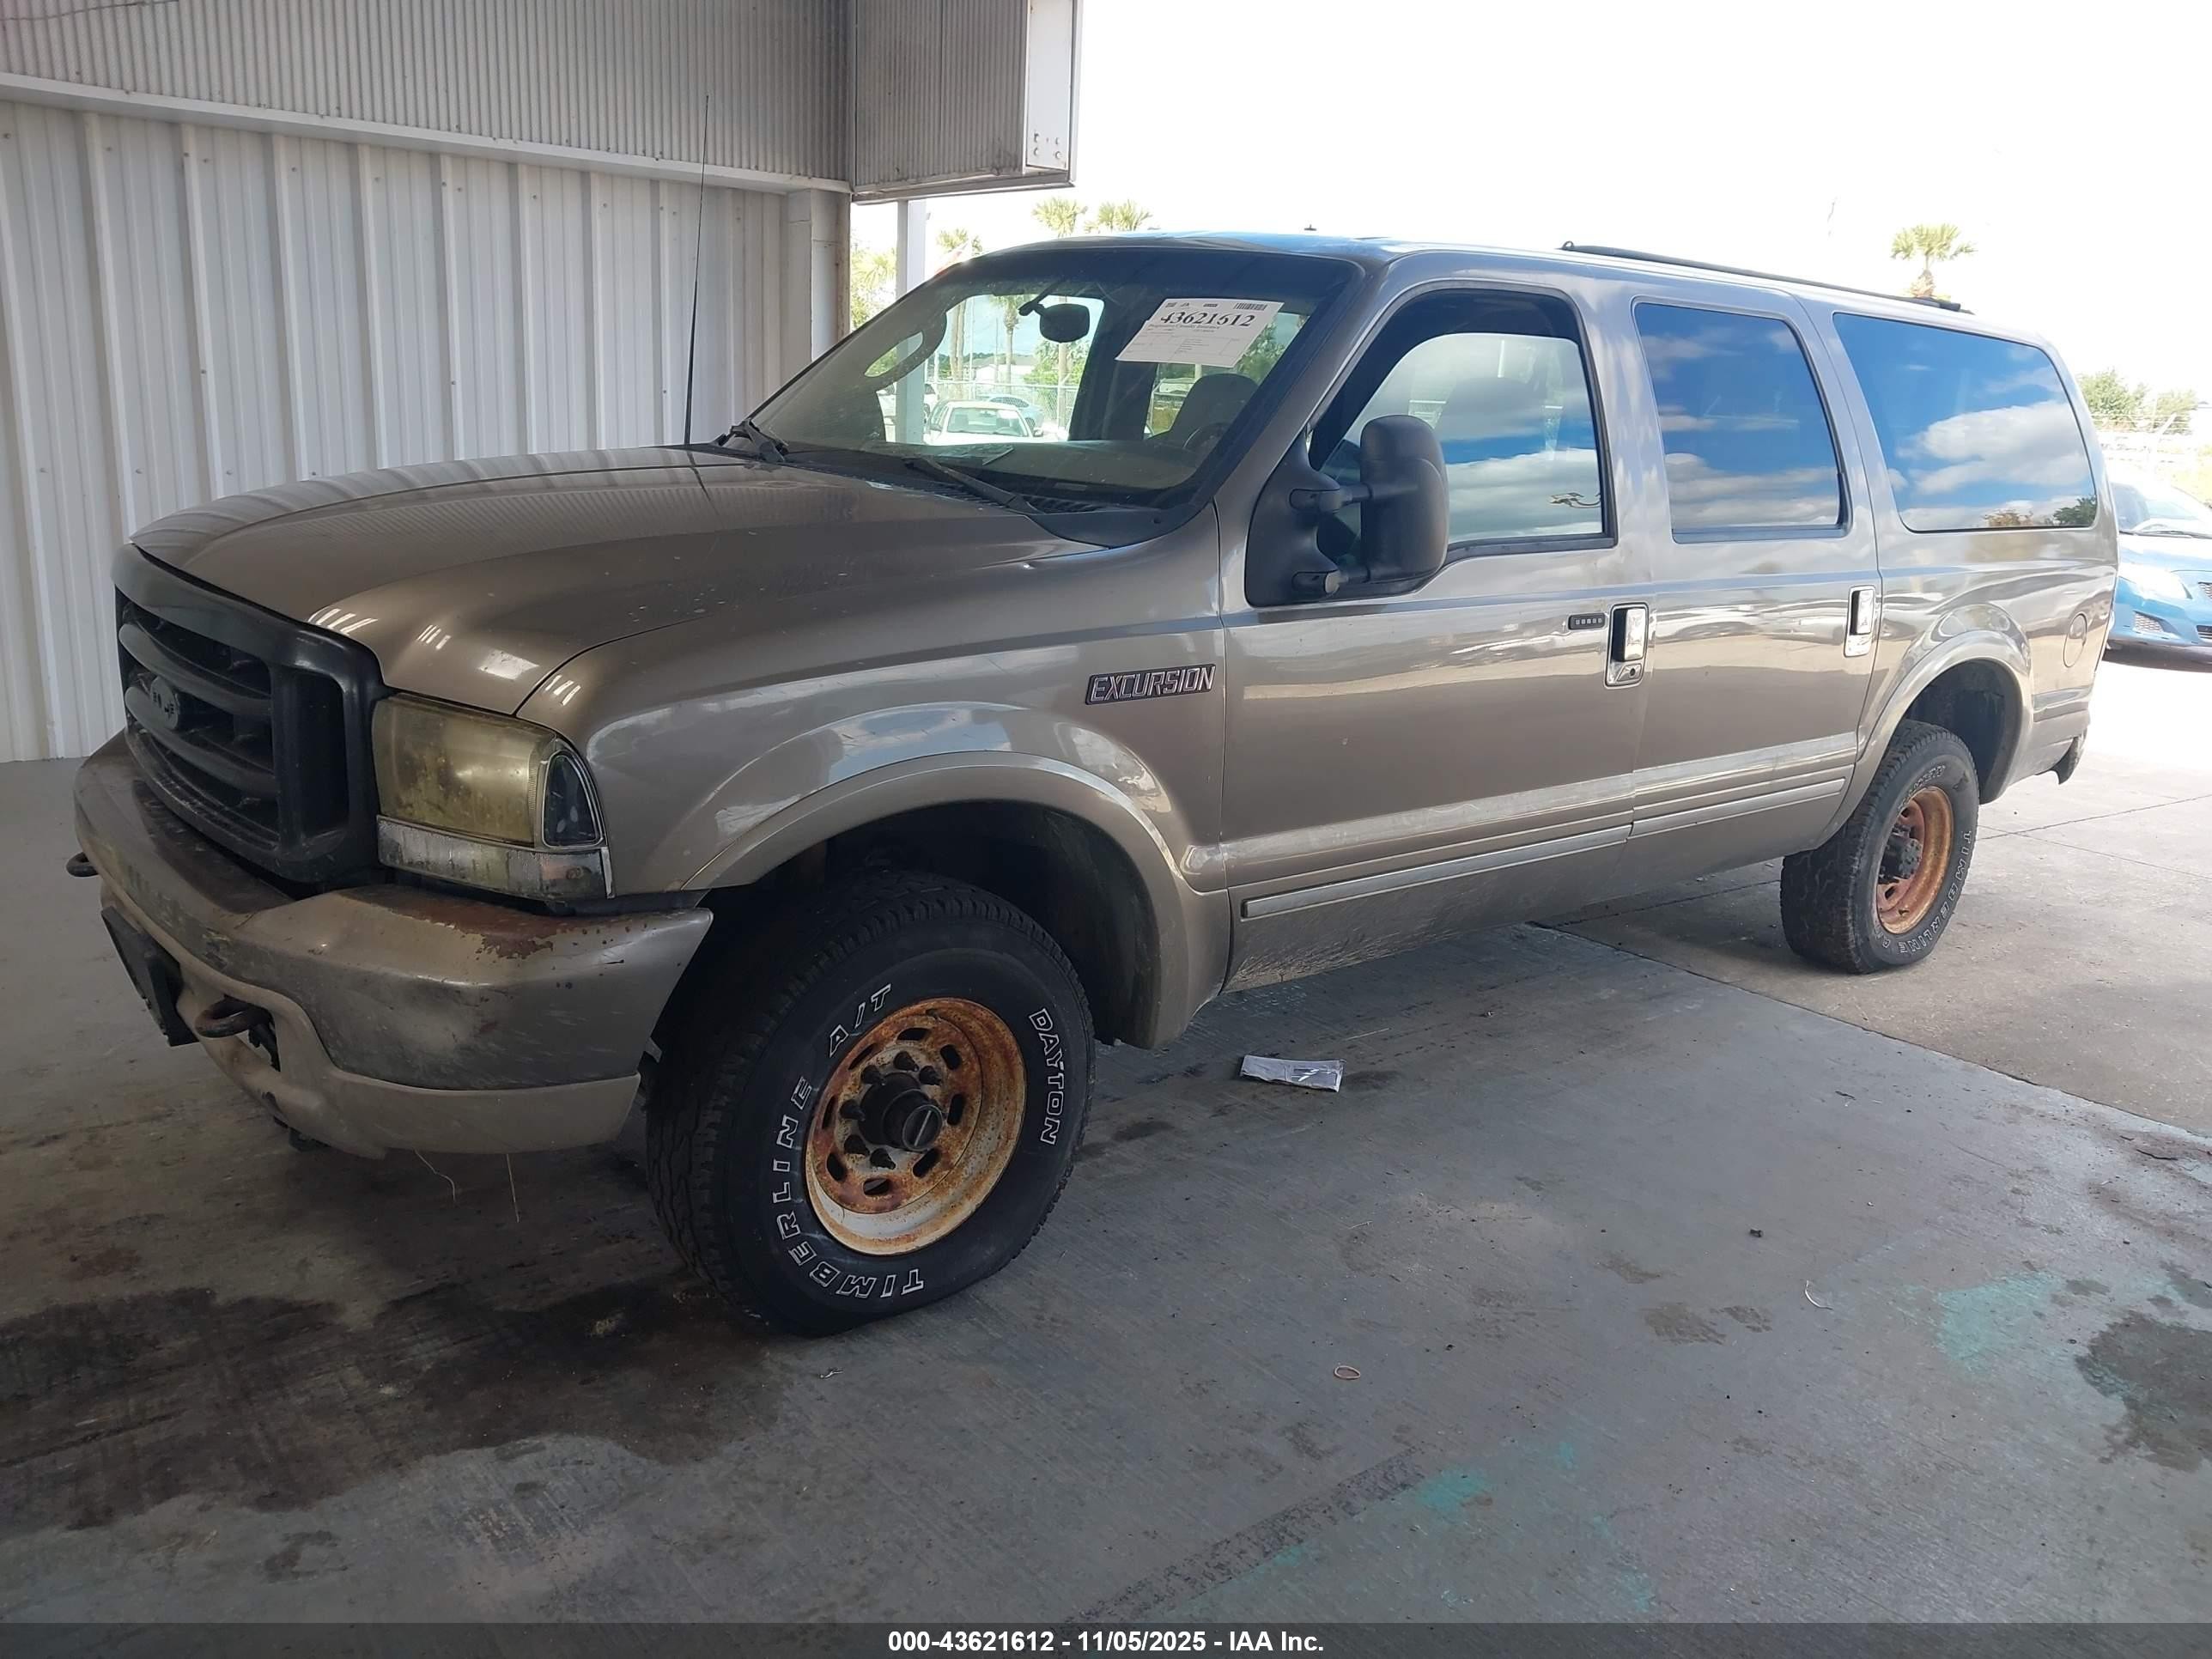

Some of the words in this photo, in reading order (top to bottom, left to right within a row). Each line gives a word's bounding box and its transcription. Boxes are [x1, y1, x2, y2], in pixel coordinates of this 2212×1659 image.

[1090, 666, 1215, 702] EXCURSION
[1029, 1008, 1065, 1146] DAYTON
[772, 1076, 926, 1298] TIMBERLINE
